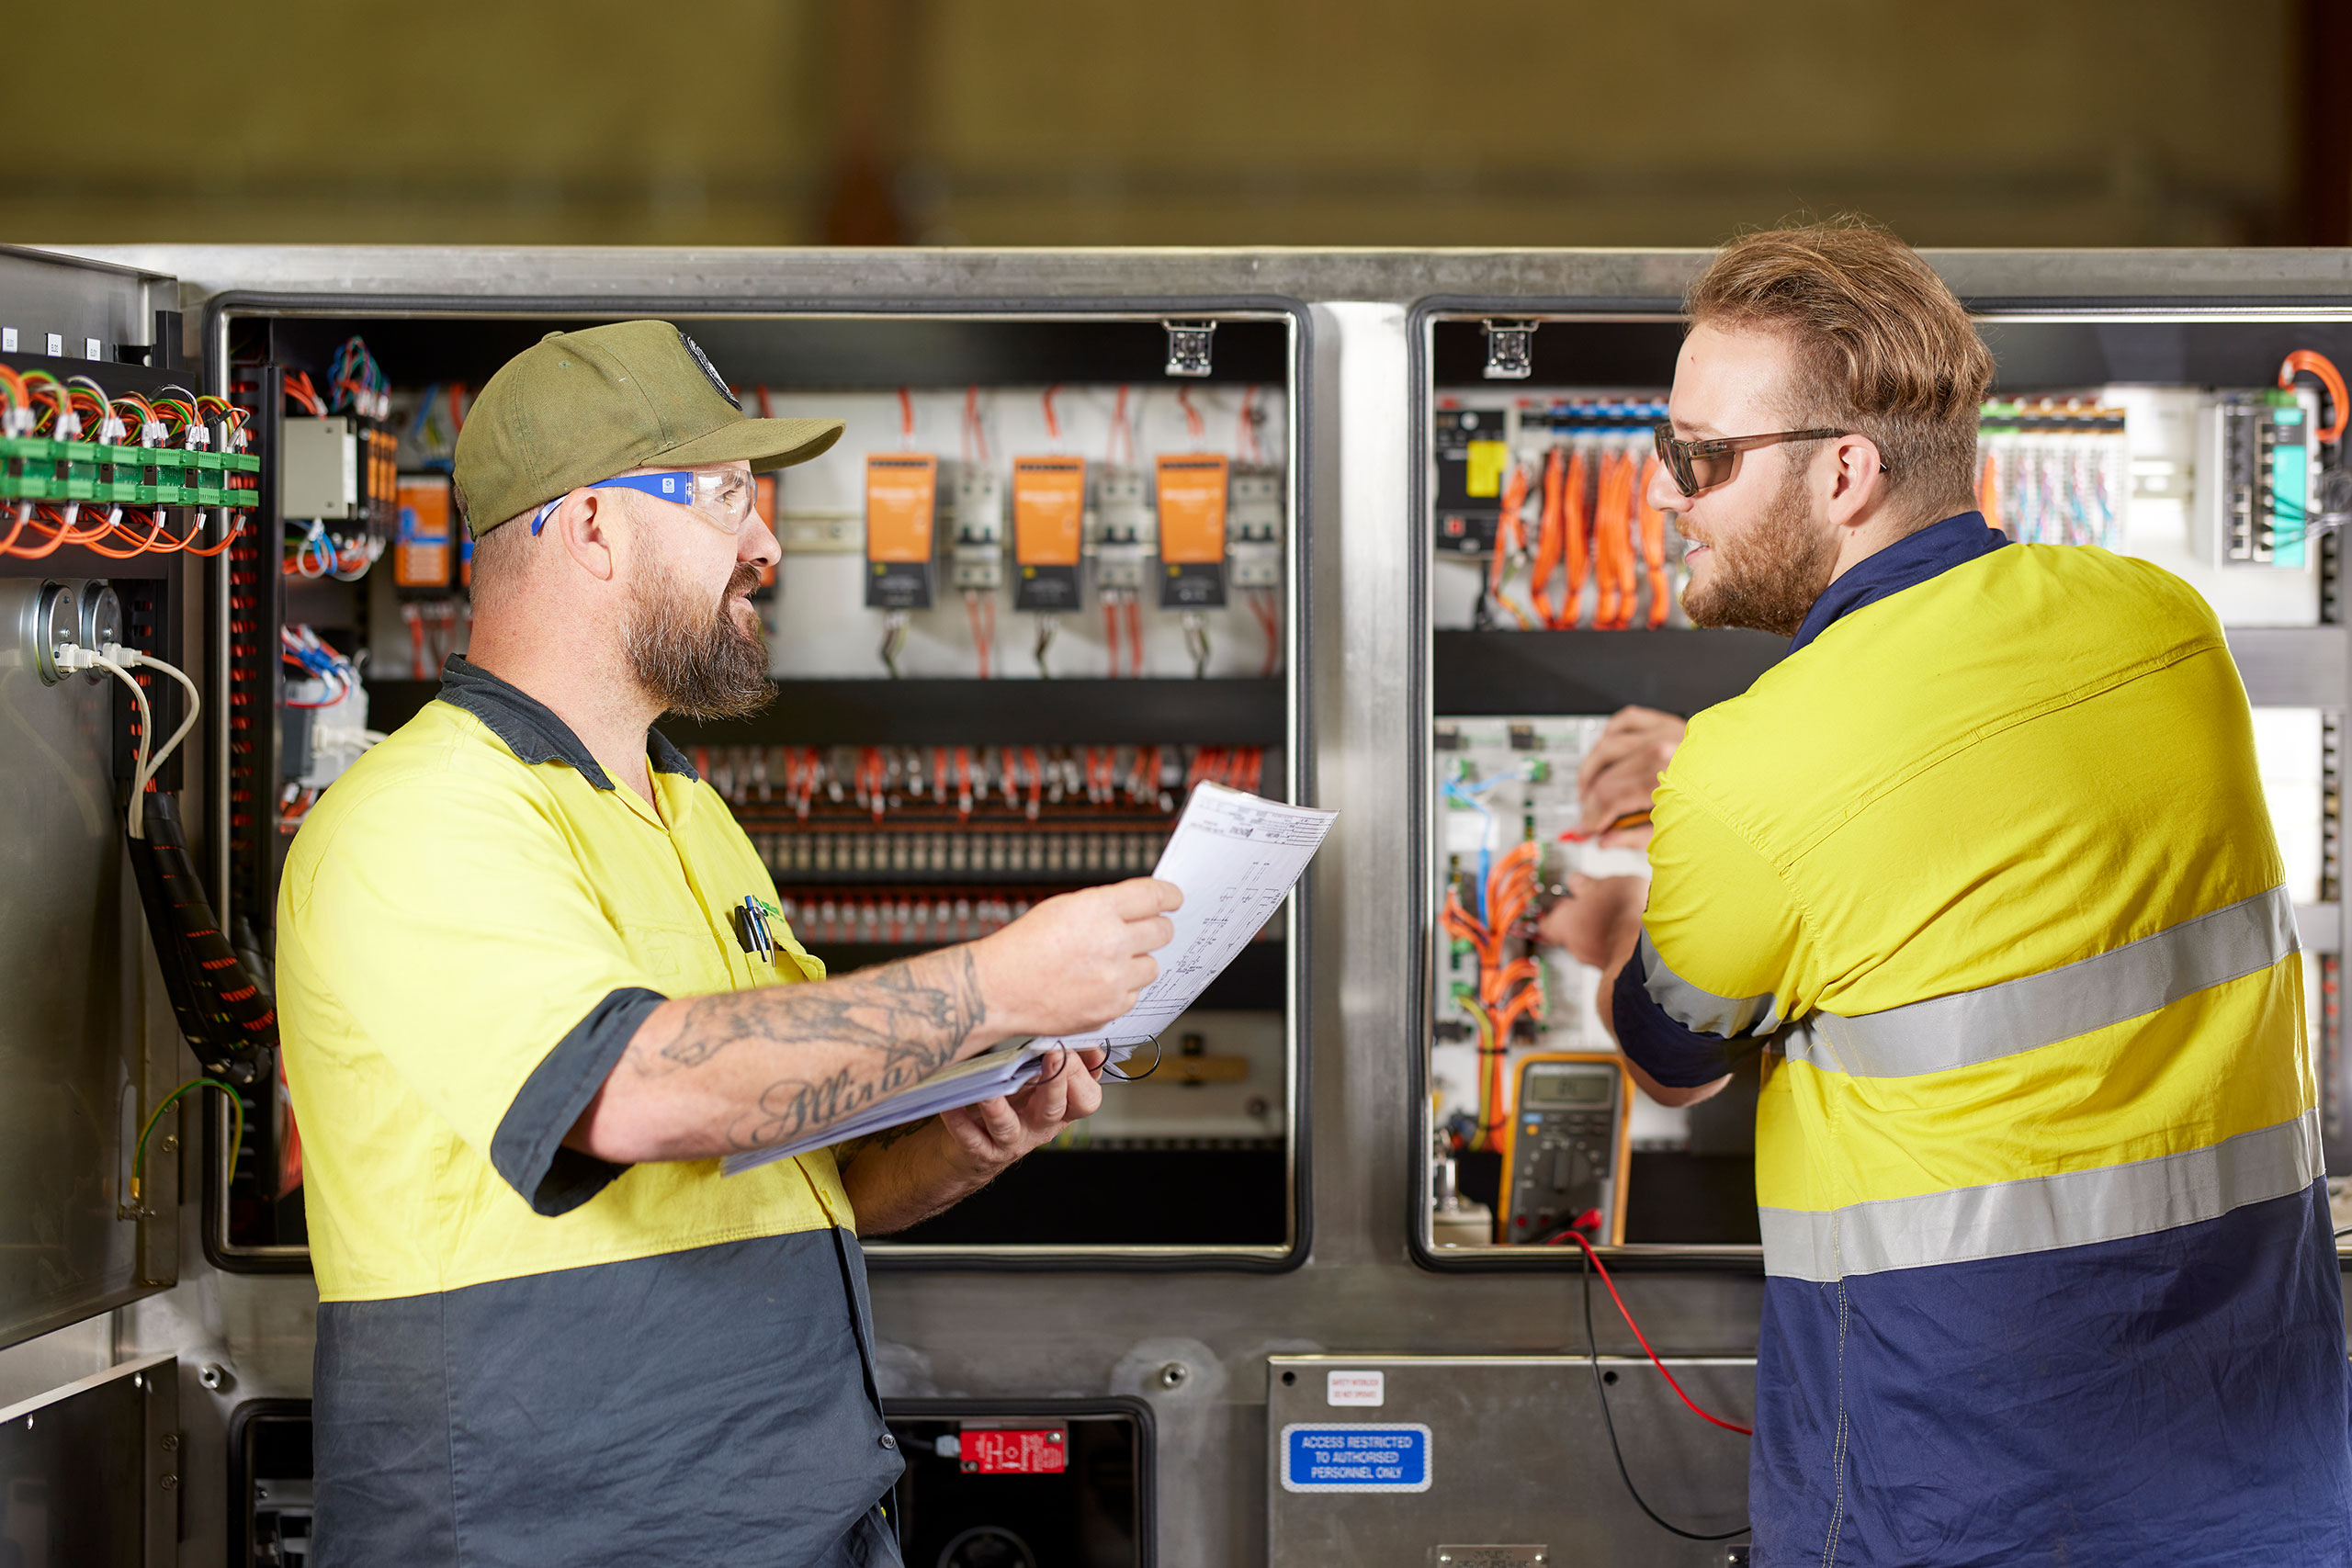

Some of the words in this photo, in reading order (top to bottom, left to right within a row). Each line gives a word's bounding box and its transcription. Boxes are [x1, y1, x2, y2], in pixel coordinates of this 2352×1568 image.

[1301, 1436, 1345, 1449] ACCESS
[1347, 1436, 1413, 1449] RESTRICTED
[1315, 1451, 1329, 1463] TO
[1332, 1451, 1399, 1463] AUTHORISED
[1311, 1467, 1374, 1479] PERSONNEL
[1375, 1467, 1403, 1479] ONLY
